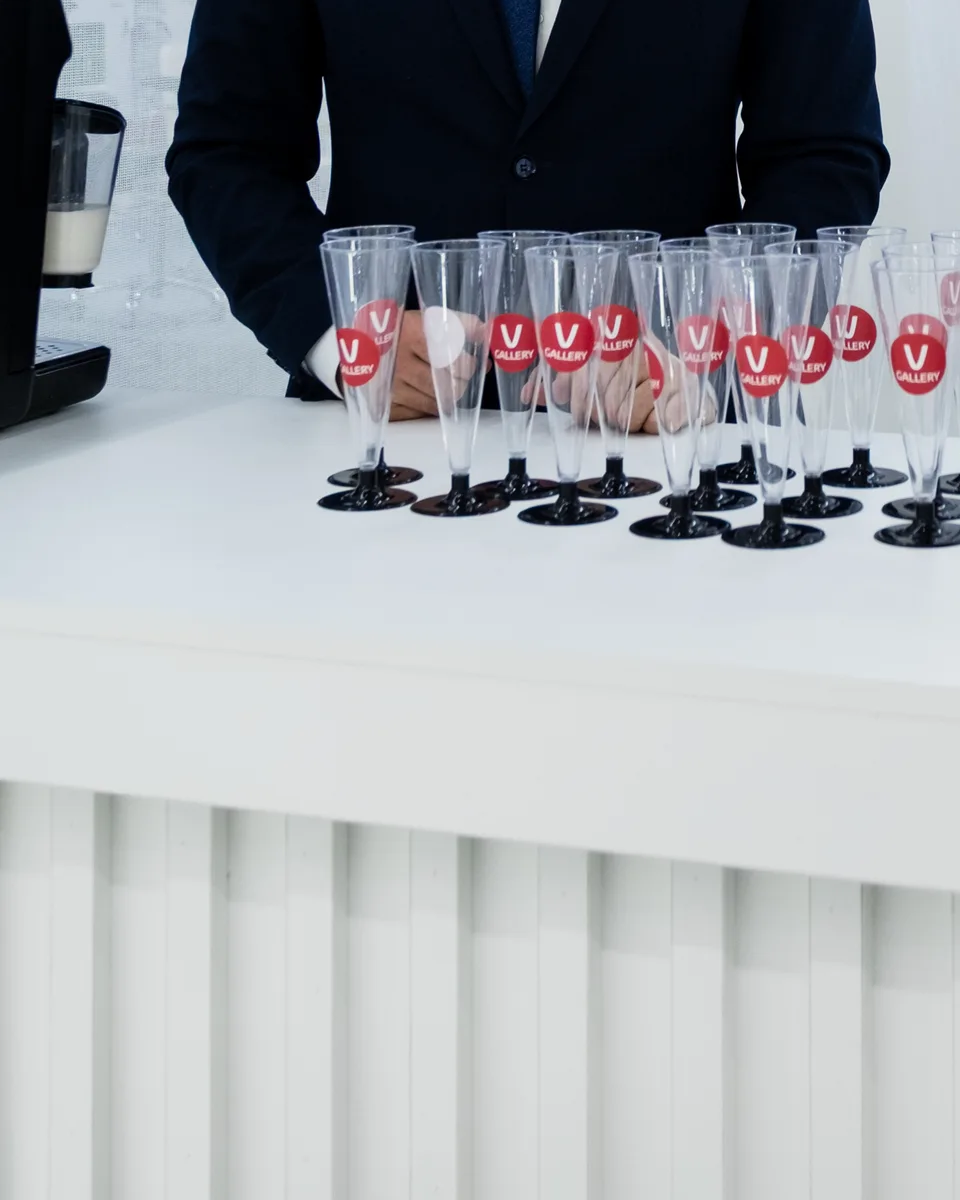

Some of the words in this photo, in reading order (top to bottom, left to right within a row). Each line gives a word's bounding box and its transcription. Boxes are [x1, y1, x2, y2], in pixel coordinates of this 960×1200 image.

[370, 308, 392, 333] V
[598, 314, 623, 340] V
[500, 324, 523, 349] V
[554, 322, 579, 349] V
[688, 325, 709, 351] V
[791, 335, 815, 361] V
[339, 338, 359, 364] V
[544, 347, 588, 362] GALLERY
[745, 345, 768, 373] V
[903, 343, 929, 371] V
[896, 370, 941, 384] GALLERY
